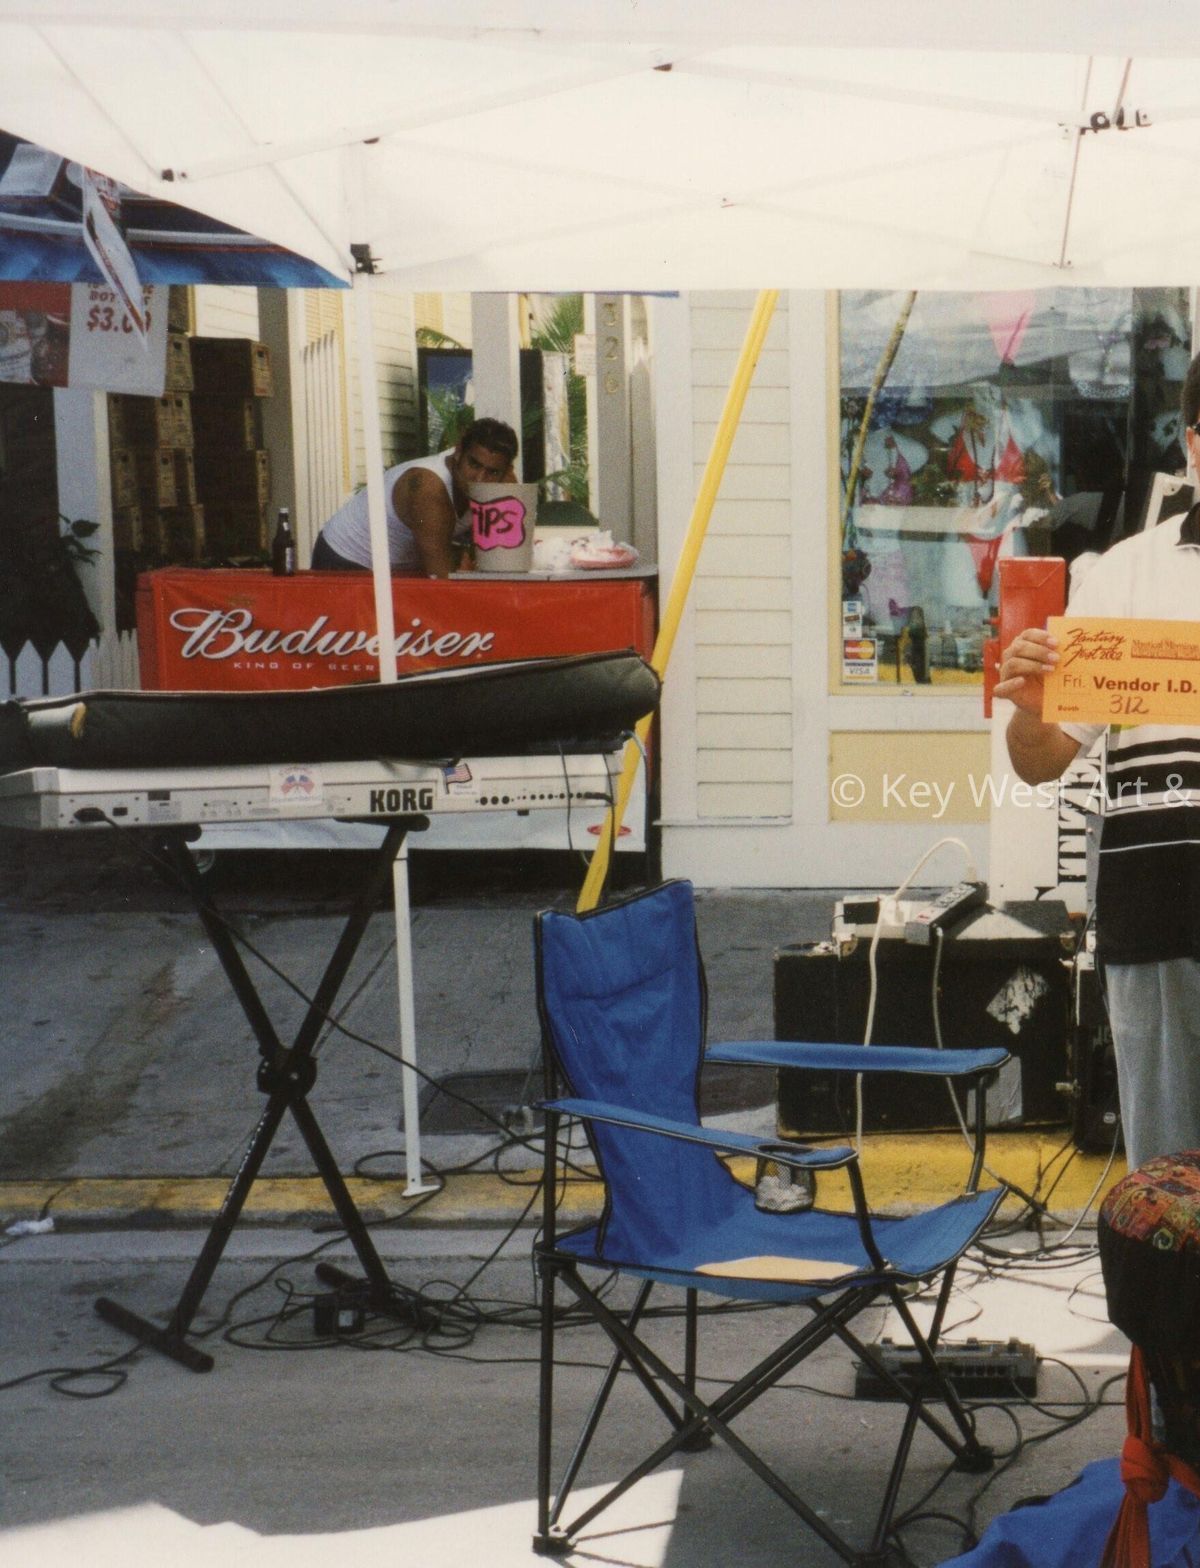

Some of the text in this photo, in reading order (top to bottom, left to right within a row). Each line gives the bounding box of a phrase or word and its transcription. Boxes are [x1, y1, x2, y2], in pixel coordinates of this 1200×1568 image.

[169, 607, 496, 660] Budweiser
[1064, 627, 1126, 652] Fantasy
[233, 661, 279, 670] KING
[292, 662, 313, 670] OF
[1063, 643, 1099, 668] Fest
[1062, 674, 1198, 694] Fri. Vendor I.D.
[1108, 693, 1150, 715] 312
[369, 788, 434, 814] KORG
